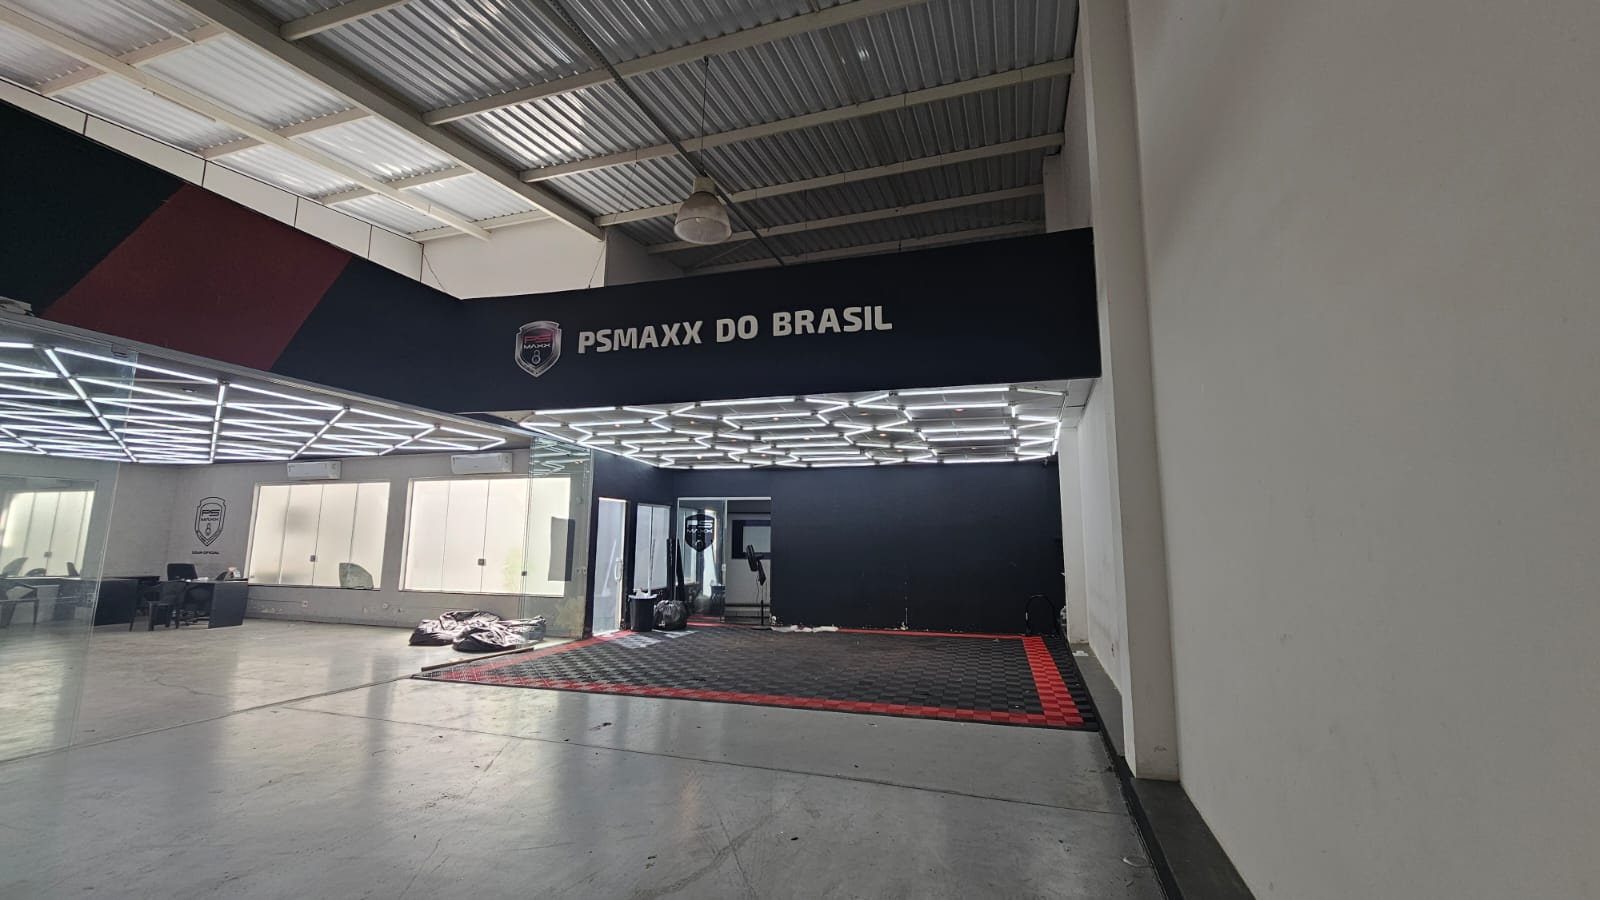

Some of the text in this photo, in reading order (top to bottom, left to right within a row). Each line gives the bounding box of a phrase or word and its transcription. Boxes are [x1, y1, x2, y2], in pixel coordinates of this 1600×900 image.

[578, 305, 893, 354] PSMAXX DO BRASIL
[524, 333, 554, 344] PS
[202, 509, 221, 517] PS
[687, 519, 714, 529] PS
